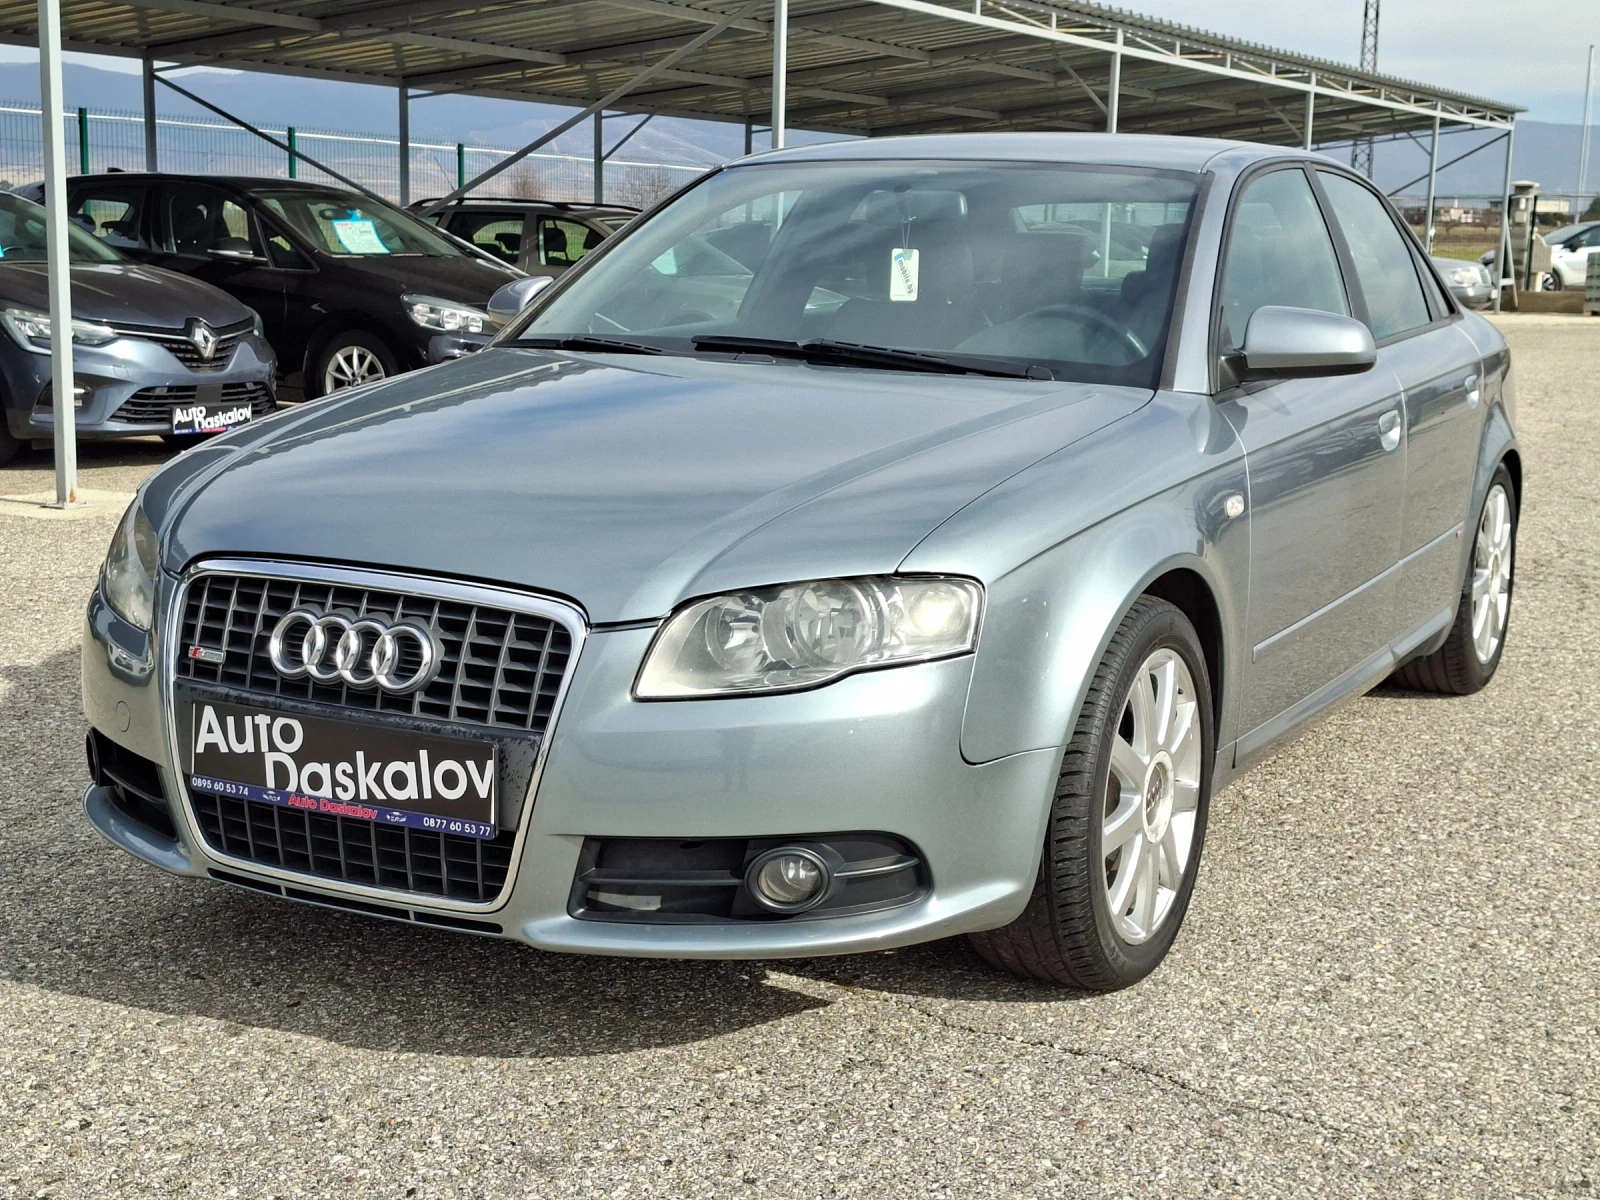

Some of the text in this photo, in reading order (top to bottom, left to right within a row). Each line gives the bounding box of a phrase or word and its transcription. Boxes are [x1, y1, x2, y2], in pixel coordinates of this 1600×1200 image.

[174, 406, 207, 425] Auto
[195, 704, 304, 754] Auto
[192, 777, 249, 796] 0895 60 53 74
[264, 749, 494, 801] Daskalov
[288, 793, 379, 820] Auto Daskalov
[423, 816, 491, 837] 0877 60 53 77
